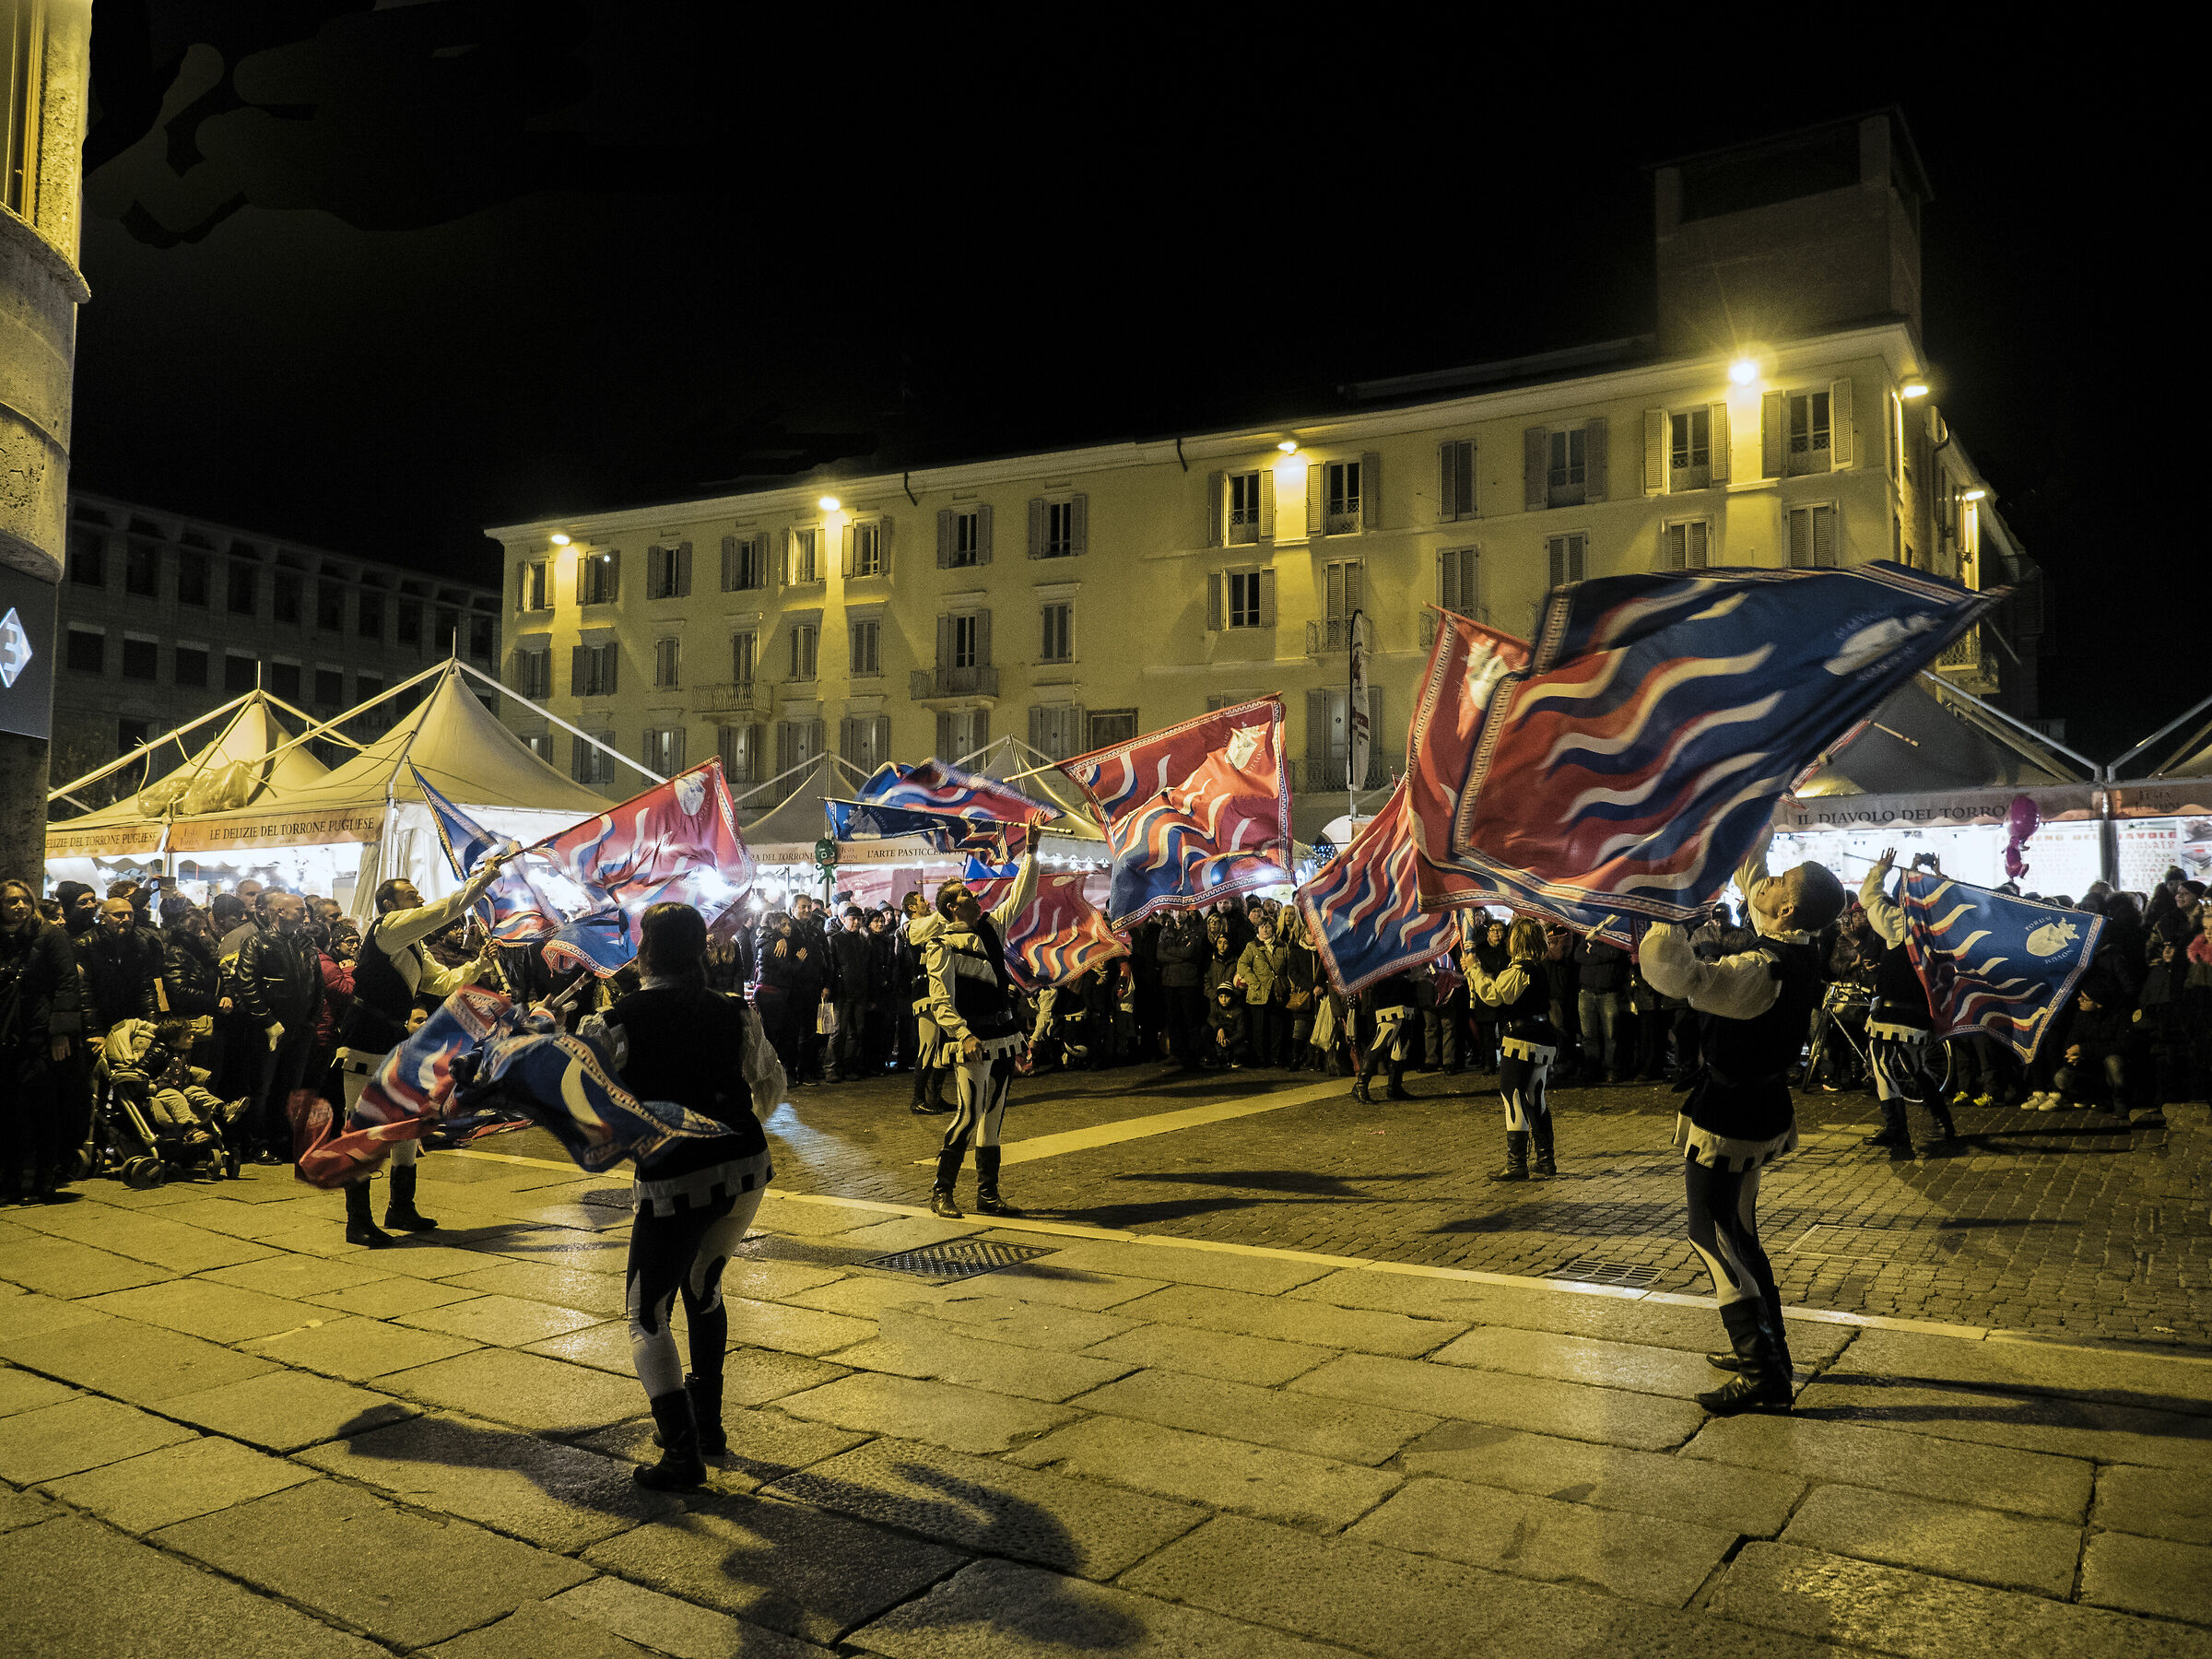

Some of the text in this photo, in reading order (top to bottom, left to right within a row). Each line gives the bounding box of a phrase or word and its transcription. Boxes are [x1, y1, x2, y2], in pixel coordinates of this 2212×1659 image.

[1797, 804, 2008, 825] IL DIAVOLO DEL TORRO
[210, 829, 220, 841] LE
[223, 827, 258, 840] DELIZIE
[261, 825, 278, 837] DEL
[280, 821, 325, 836] TORRONE
[328, 817, 374, 831] PUGLIESE
[69, 836, 83, 847] DEL
[85, 834, 120, 847] TORRONE
[778, 852, 815, 862] TORRONE
[866, 849, 896, 858] L'ARTE
